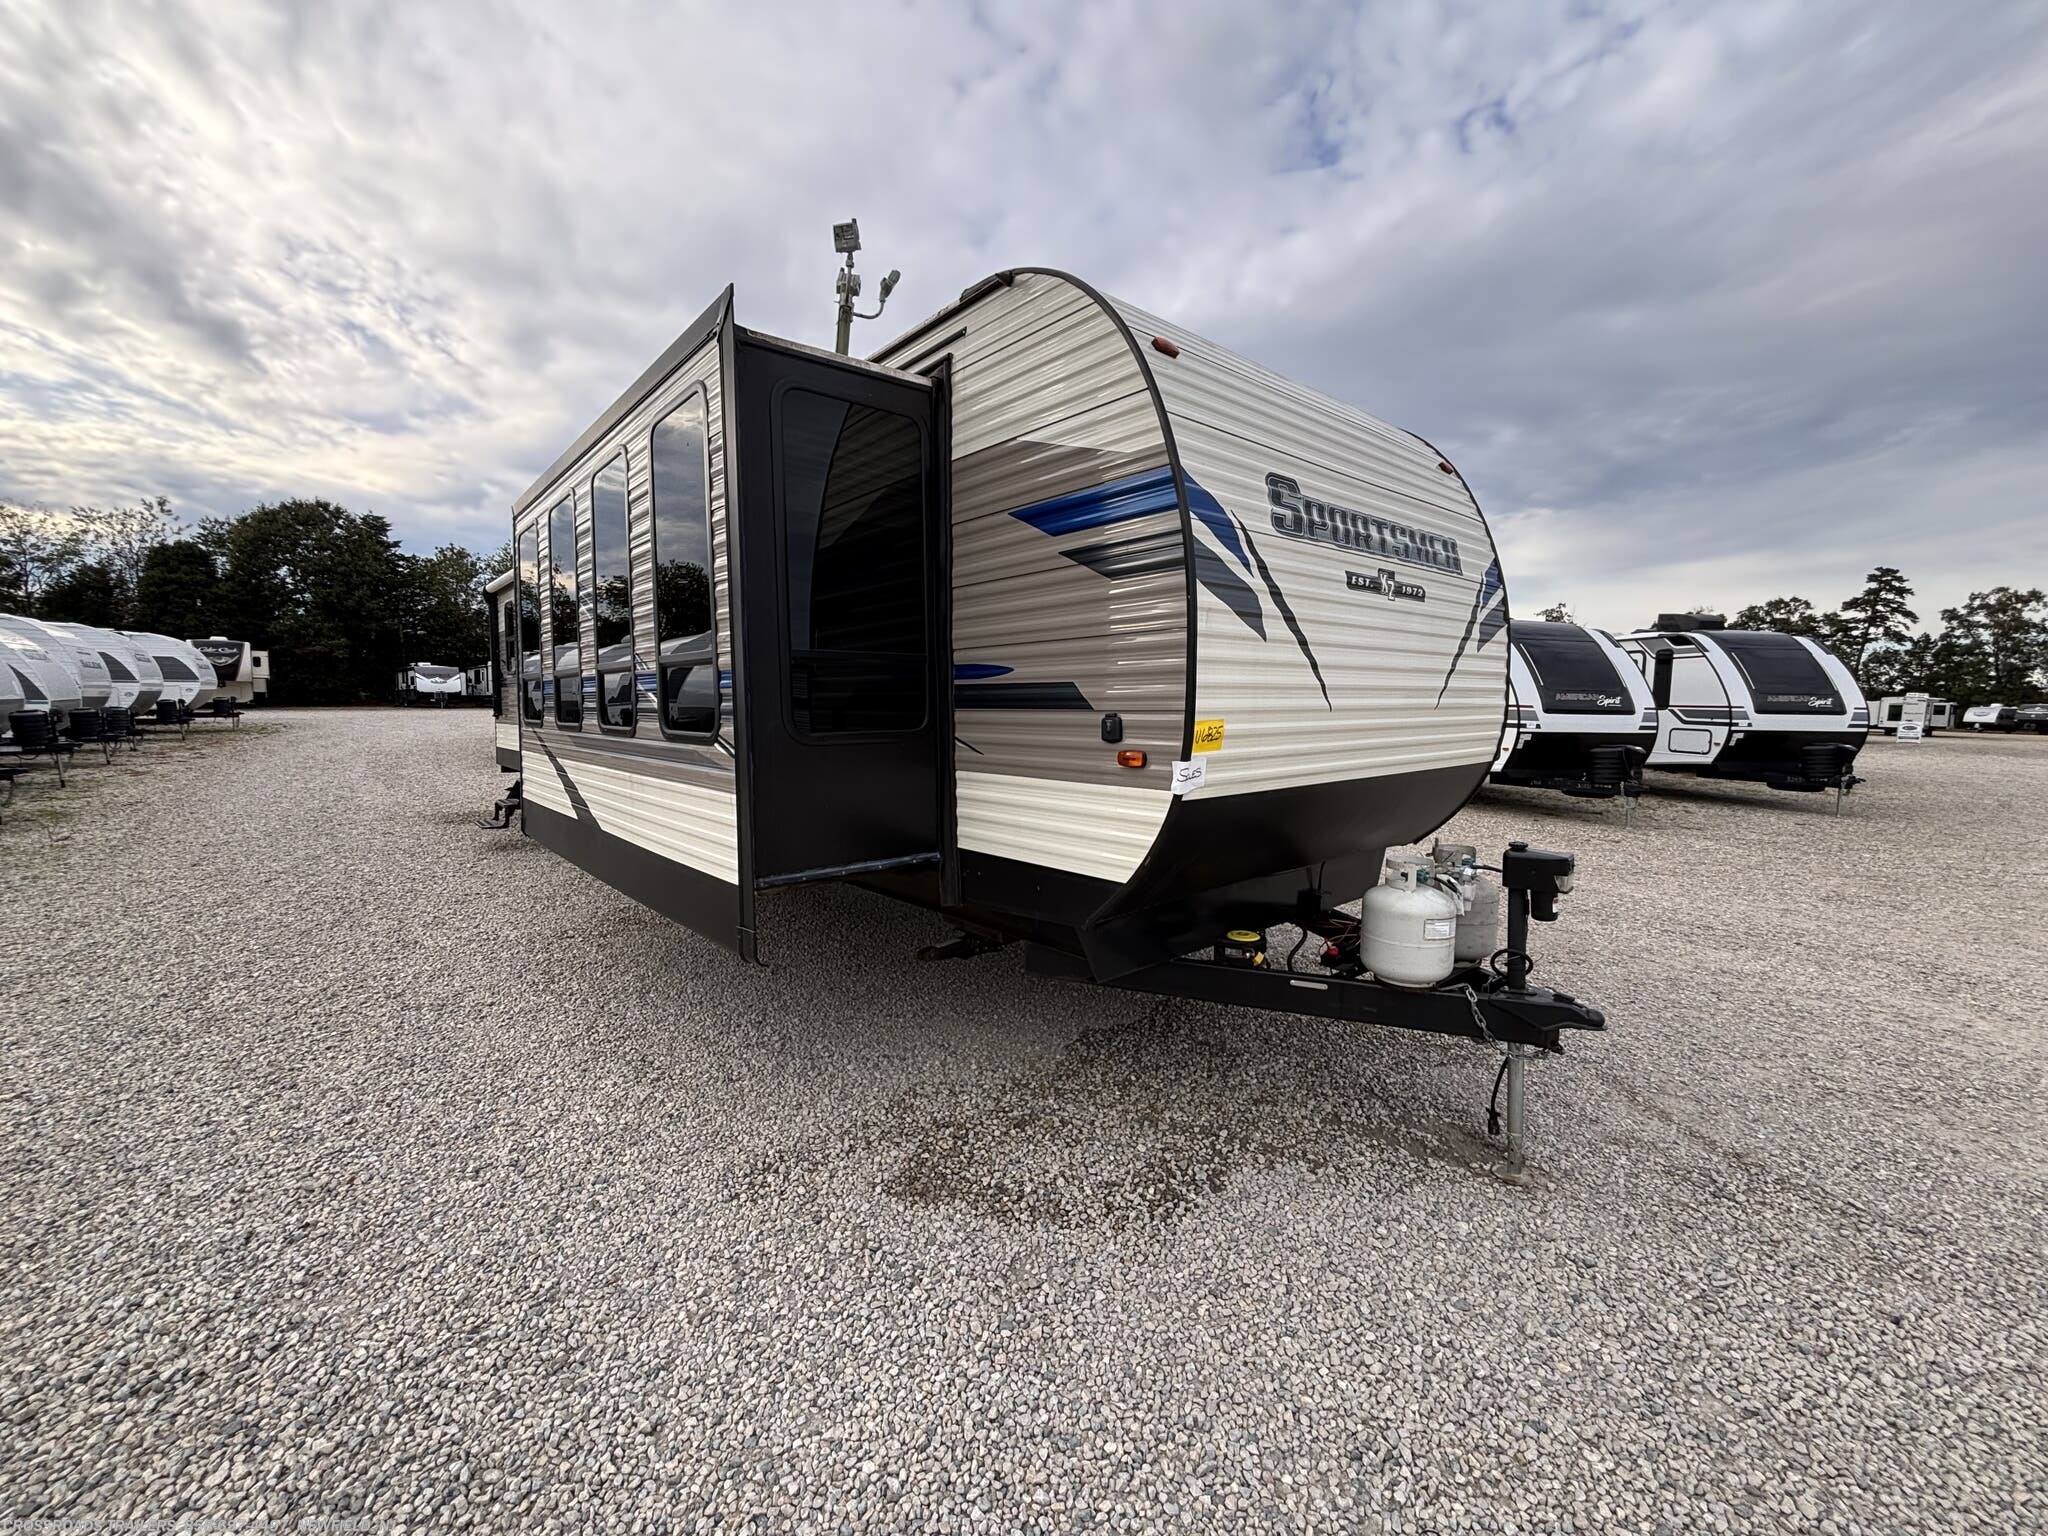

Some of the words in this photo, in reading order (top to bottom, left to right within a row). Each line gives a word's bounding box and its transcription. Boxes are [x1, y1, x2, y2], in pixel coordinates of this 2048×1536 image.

[1351, 576, 1374, 588] EST.
[1402, 585, 1424, 597] 1972
[1596, 694, 1622, 708] Spirit
[1808, 696, 1834, 708] Spirit
